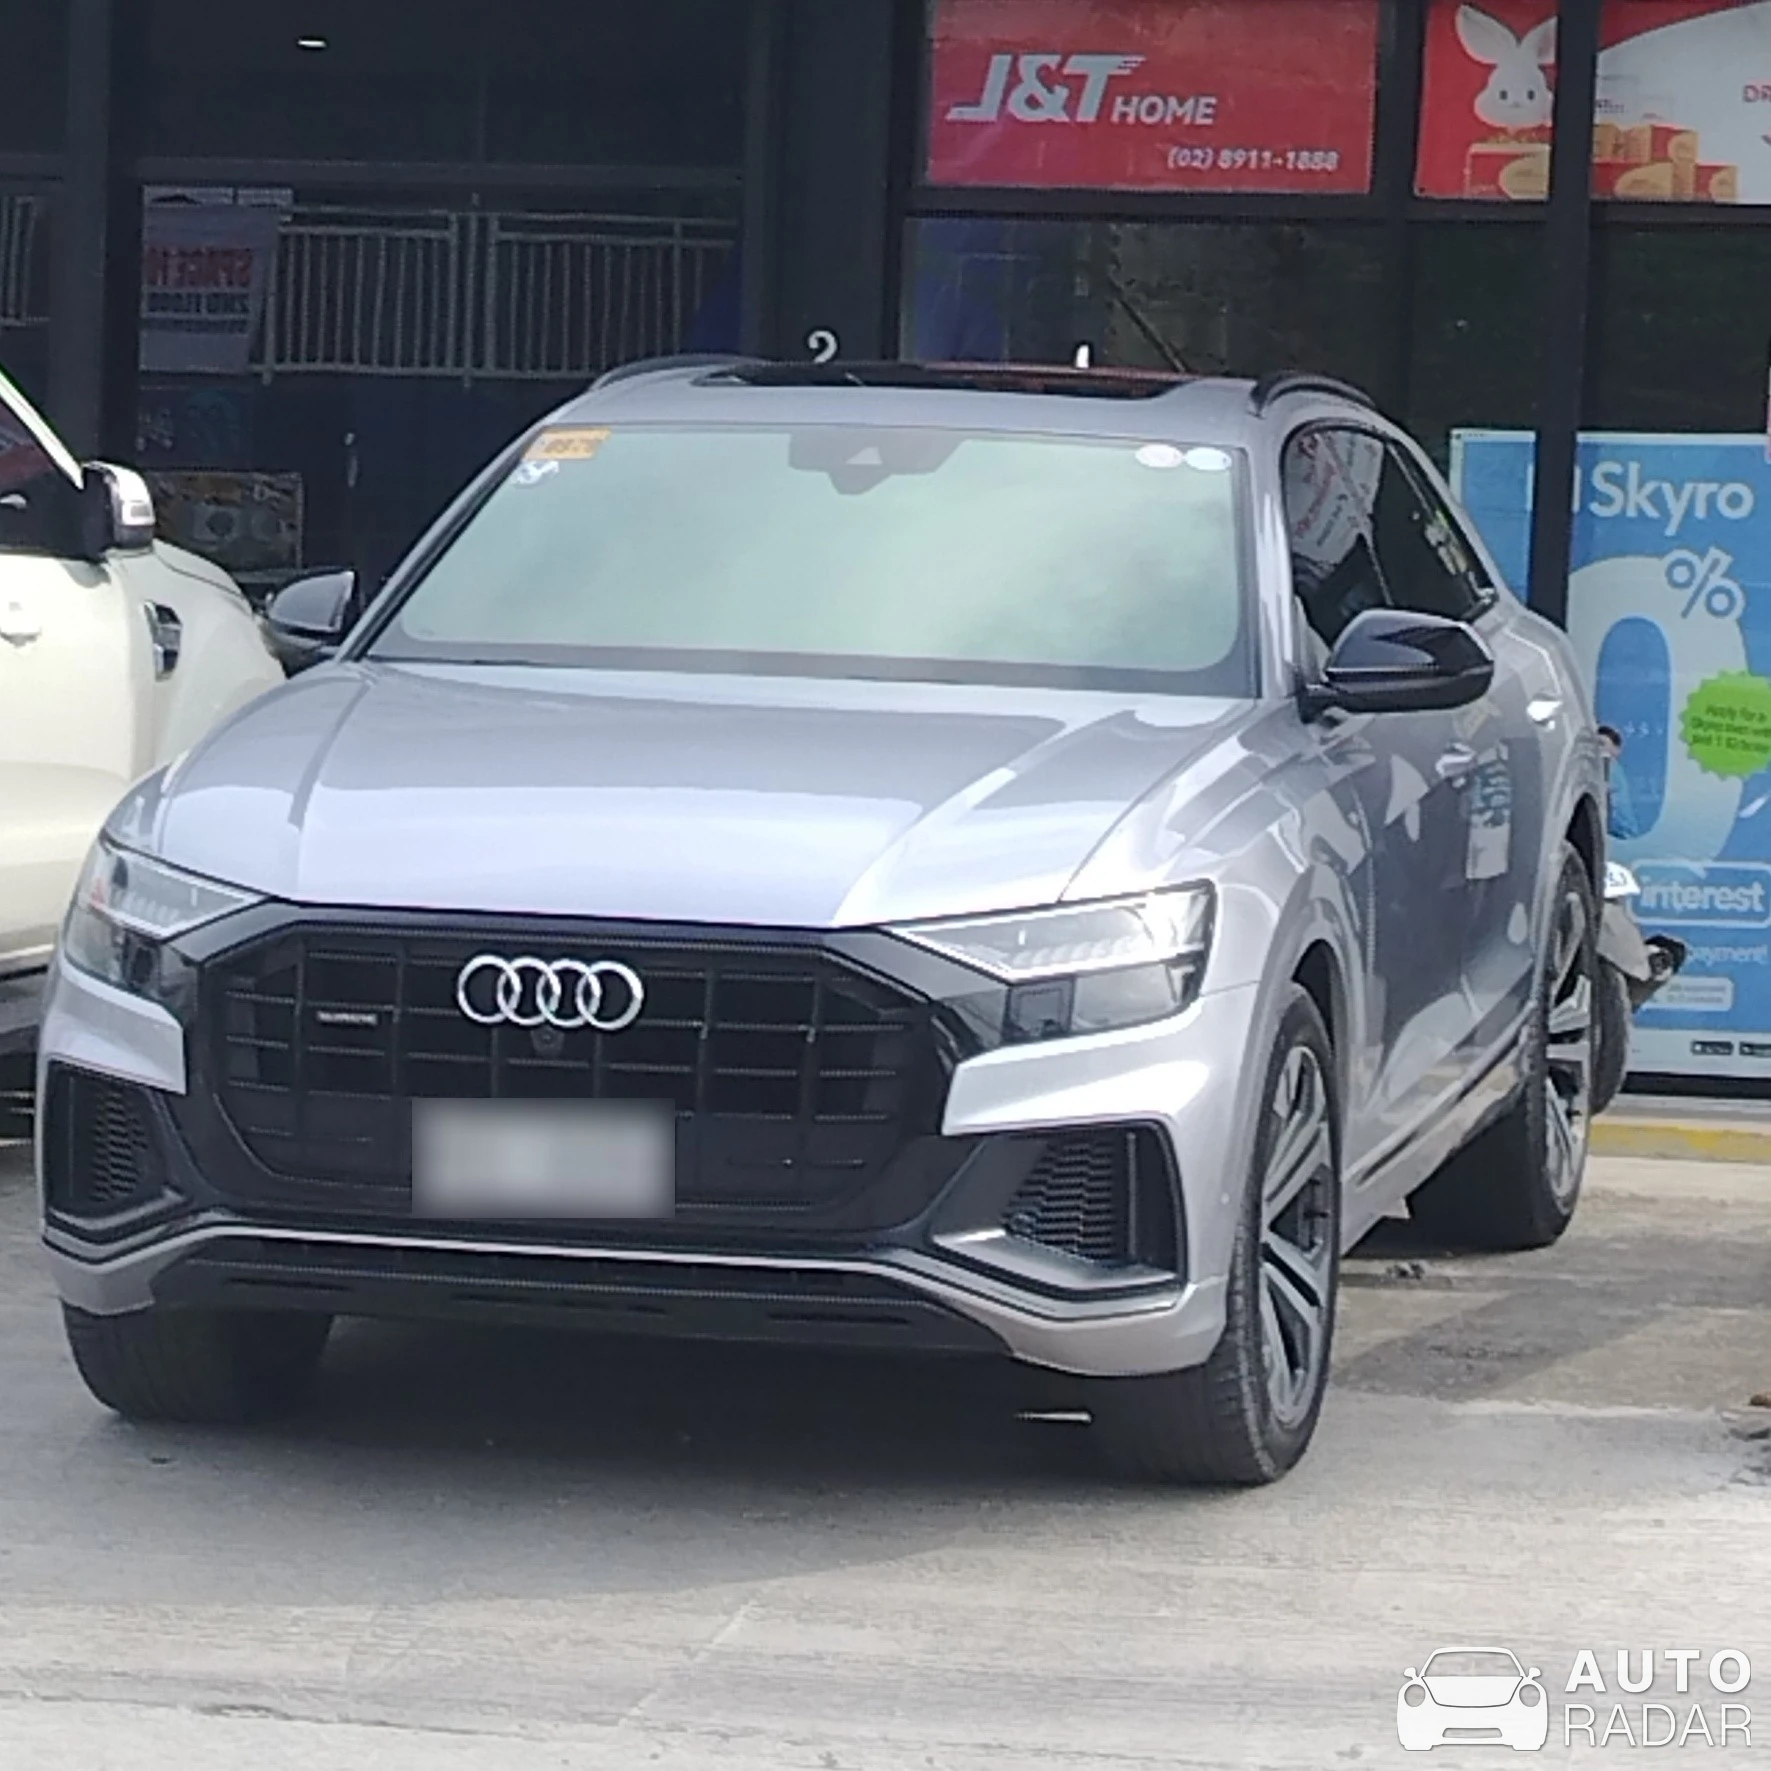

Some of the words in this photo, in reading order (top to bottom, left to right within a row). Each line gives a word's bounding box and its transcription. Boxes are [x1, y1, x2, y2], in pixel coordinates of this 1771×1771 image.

[946, 54, 1147, 123] J&T
[1111, 95, 1217, 125] HOME
[1167, 146, 1214, 170] (02)
[1588, 461, 1755, 537] Skyro
[1640, 876, 1765, 912] interest
